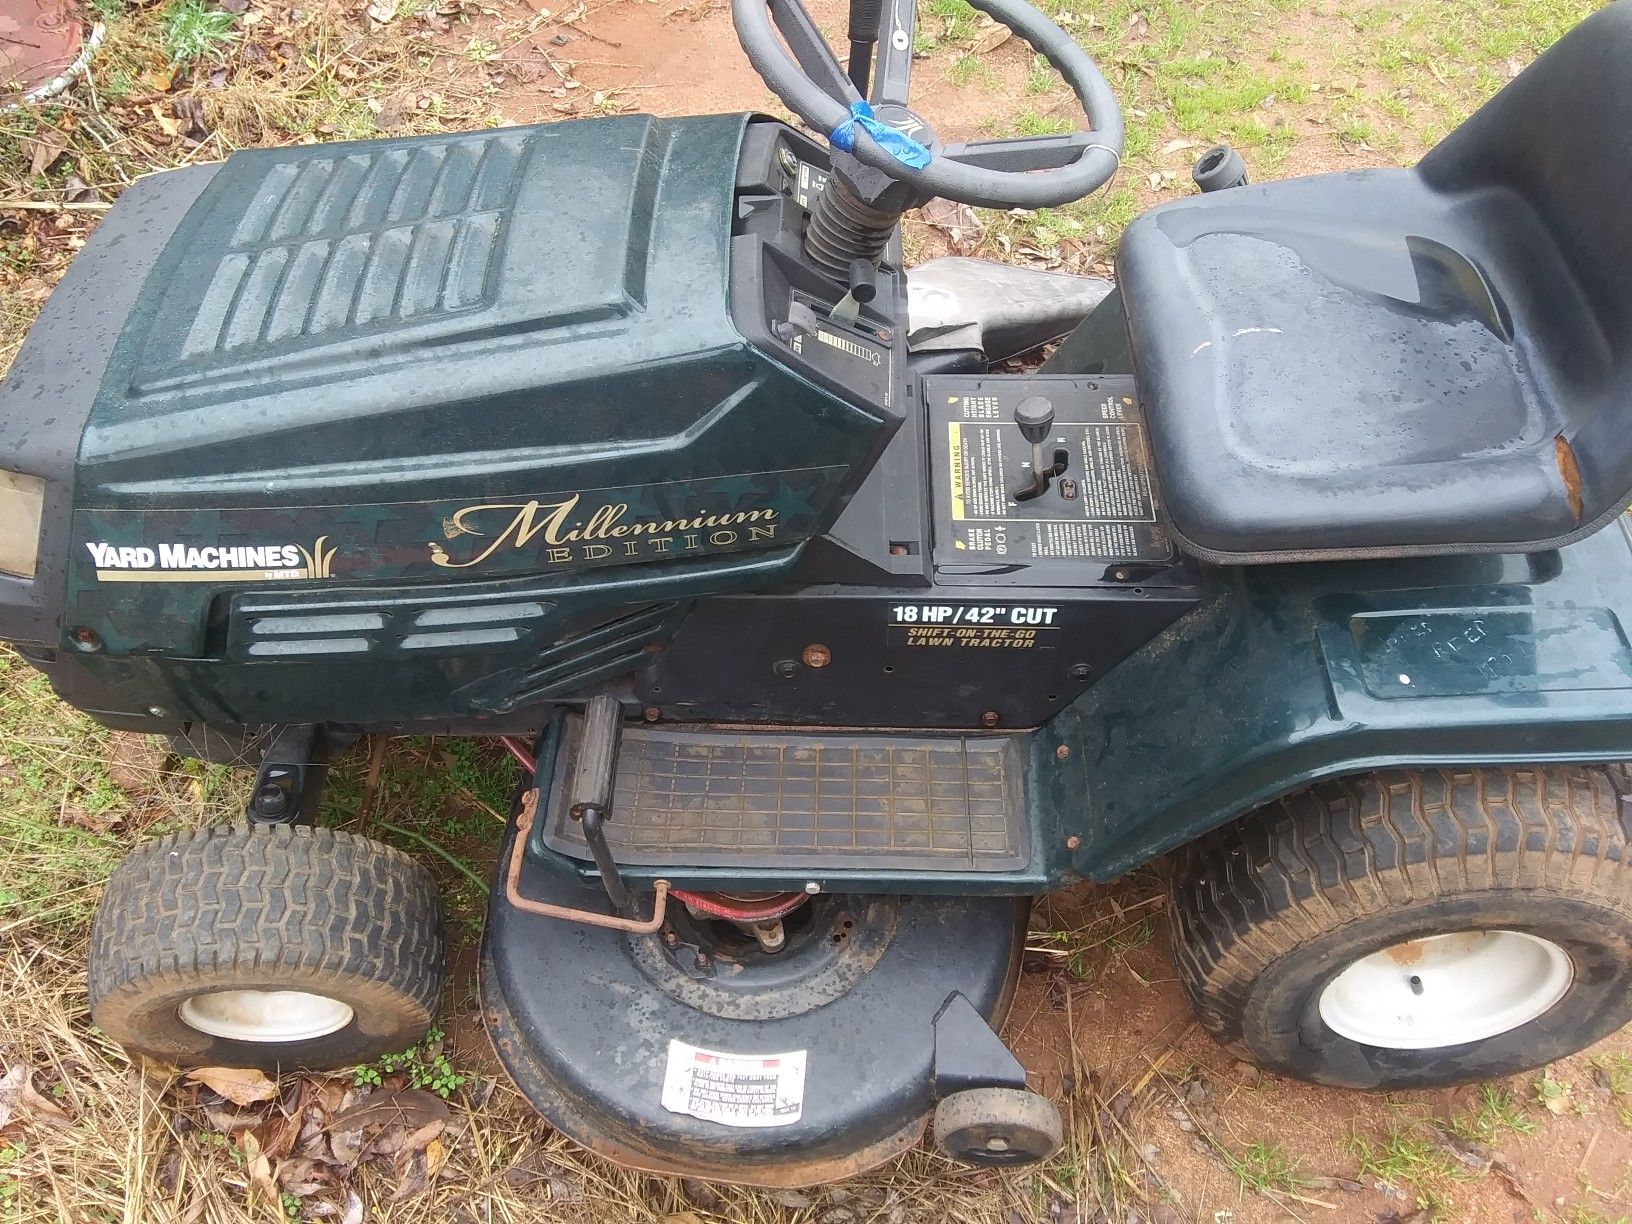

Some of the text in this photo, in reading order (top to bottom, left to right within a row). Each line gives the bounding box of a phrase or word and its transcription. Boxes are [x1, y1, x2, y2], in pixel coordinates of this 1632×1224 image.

[1100, 403, 1108, 419] SPEED
[1106, 396, 1116, 419] CONTROL
[1115, 402, 1124, 419] LEVER
[953, 445, 962, 488] WARNING
[428, 493, 781, 568] Millennium
[546, 524, 778, 563] EDITION
[86, 542, 300, 568] YARD MACHINES
[892, 606, 918, 622] 18
[1010, 607, 1058, 625] CUT
[906, 637, 1036, 648] LAWN TRACTOR
[907, 628, 1036, 639] SHIFT-ON-THE-GO
